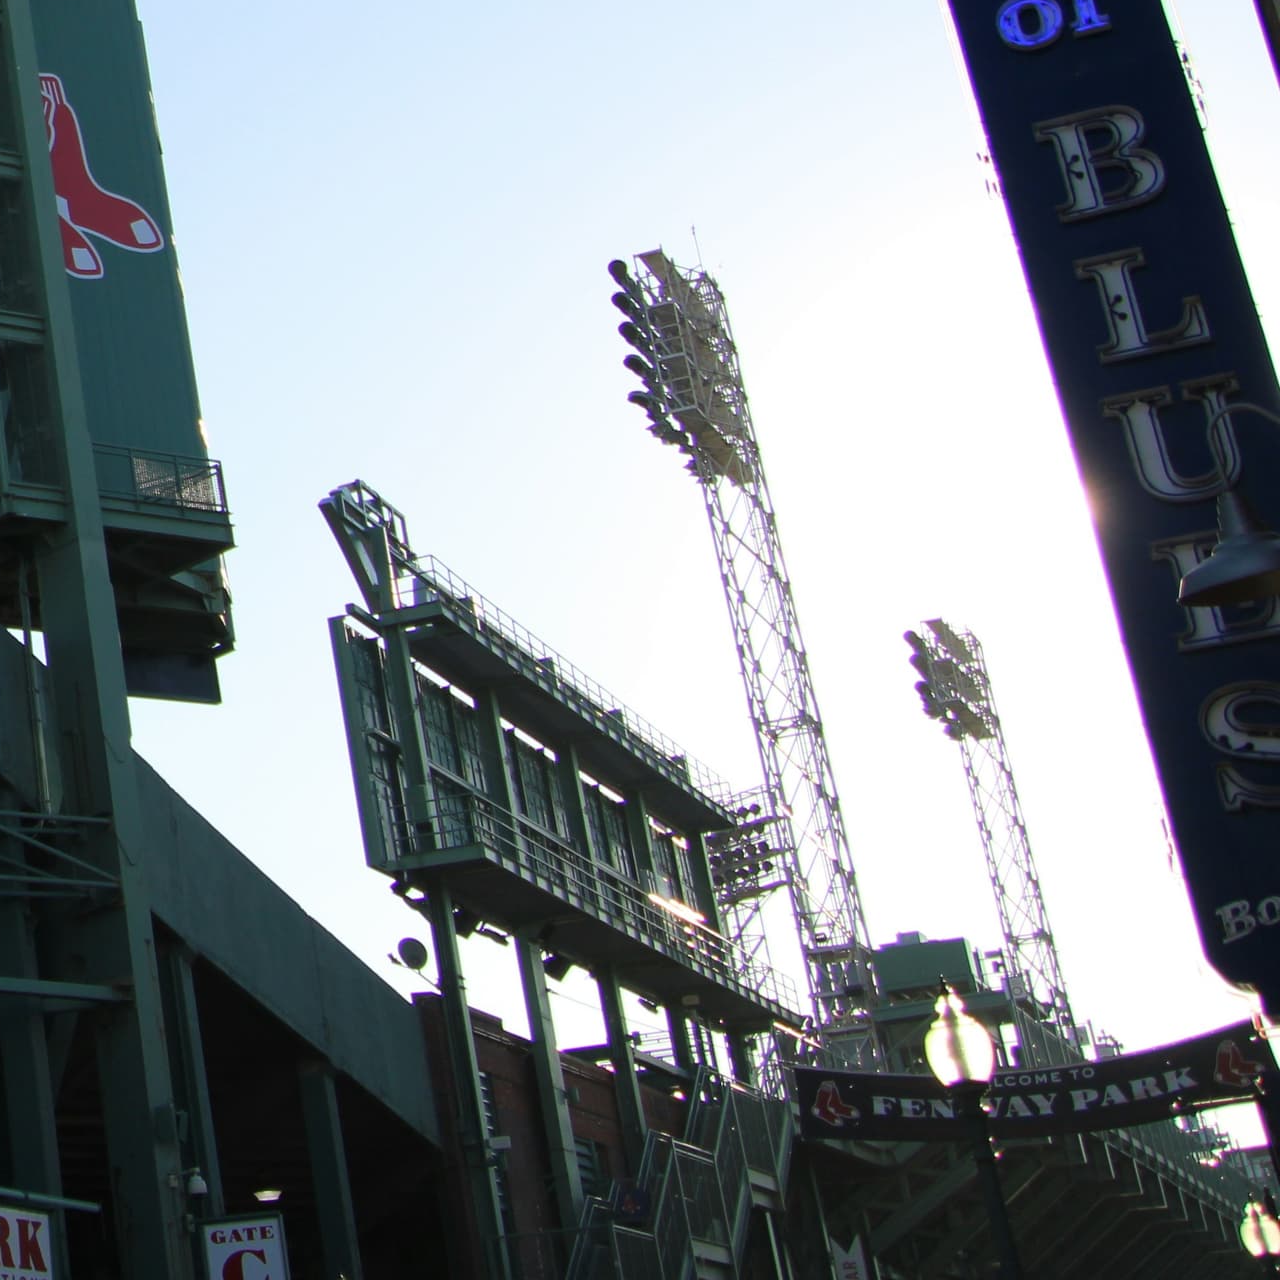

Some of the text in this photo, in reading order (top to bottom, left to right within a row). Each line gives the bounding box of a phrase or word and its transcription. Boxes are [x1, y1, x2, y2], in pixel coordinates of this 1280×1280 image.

[1068, 1067, 1095, 1081] TO
[1069, 1067, 1199, 1113] PARK
[210, 1226, 275, 1244] GATE
